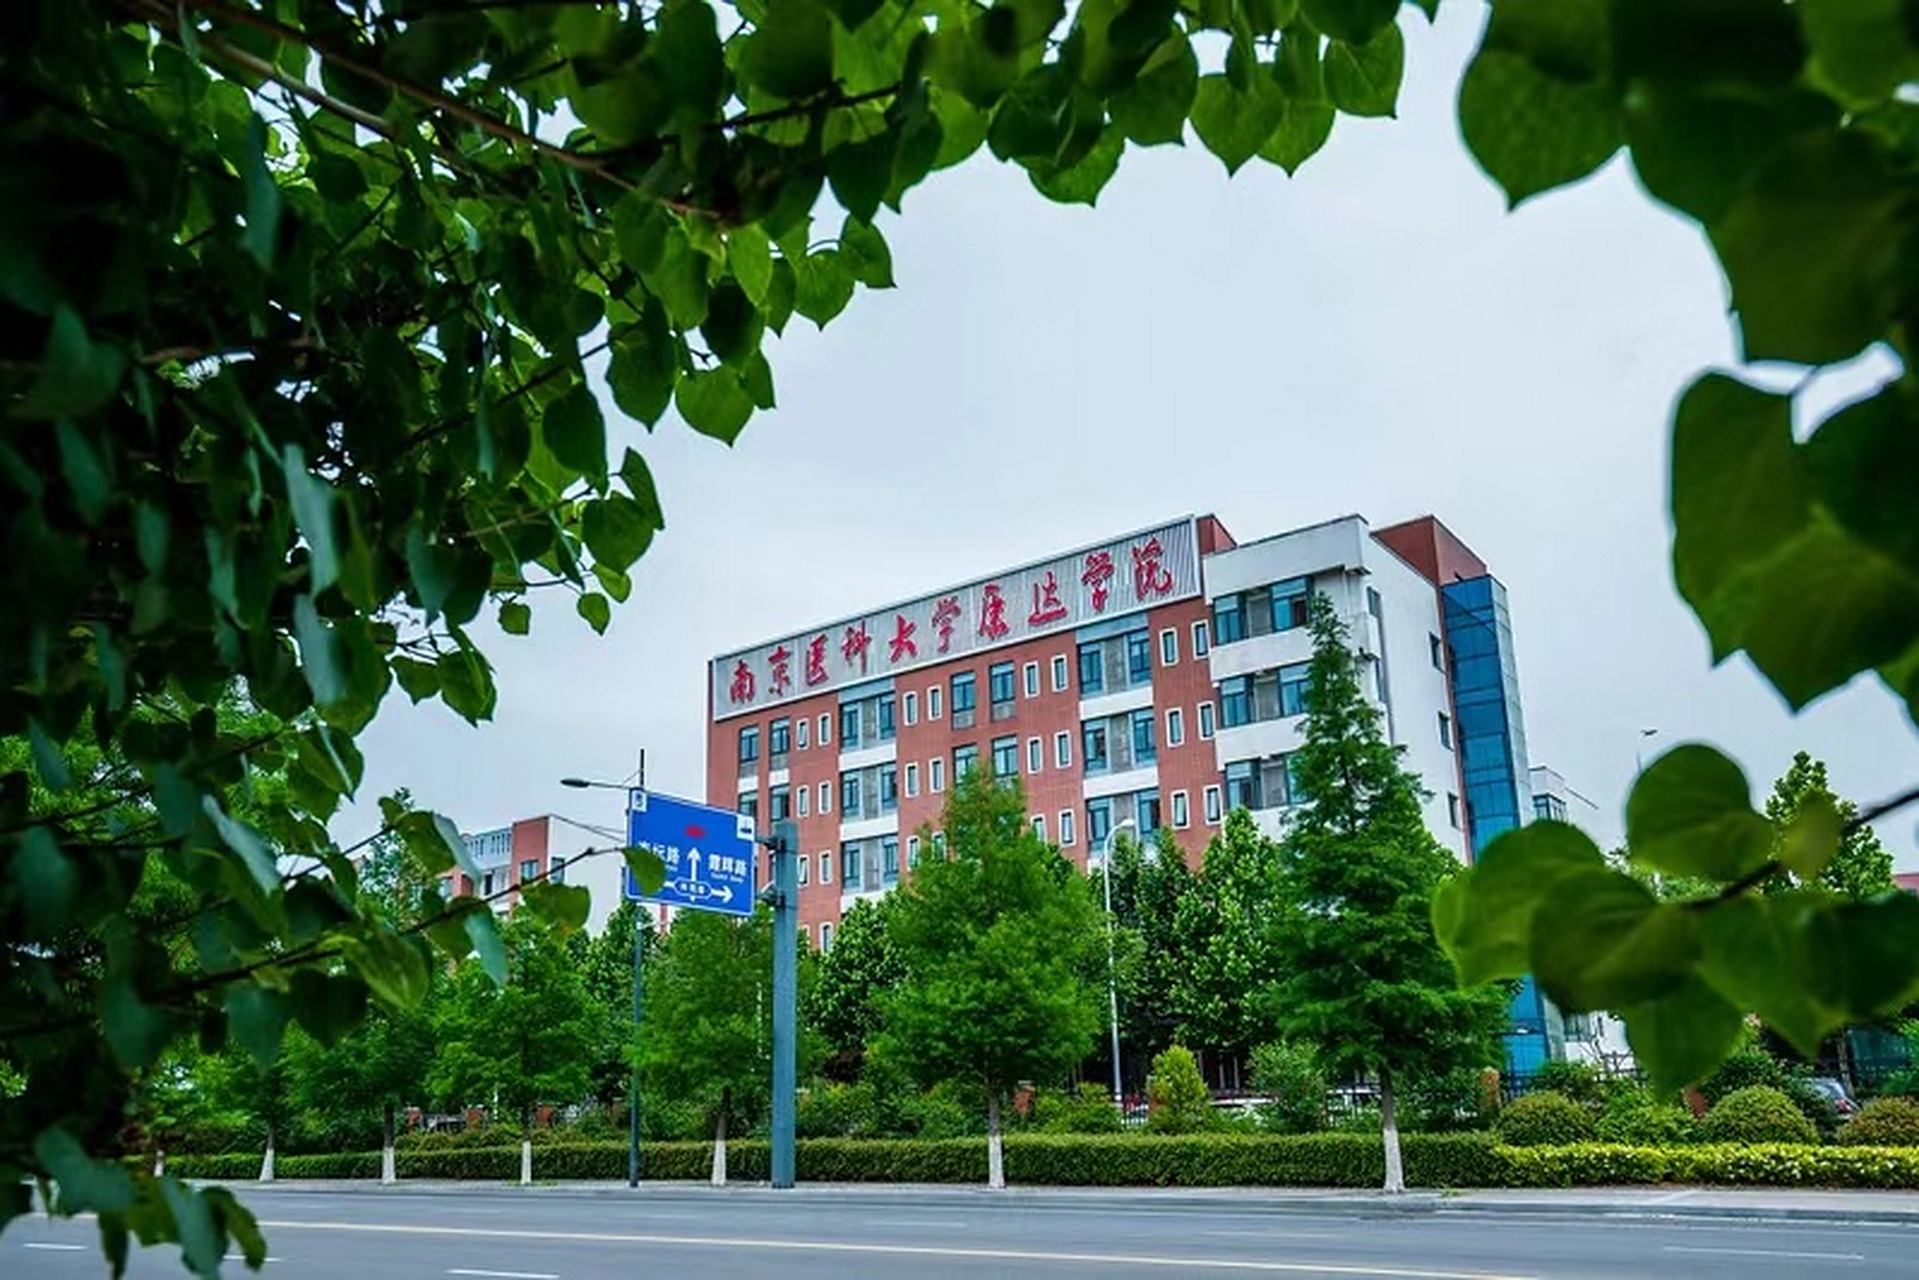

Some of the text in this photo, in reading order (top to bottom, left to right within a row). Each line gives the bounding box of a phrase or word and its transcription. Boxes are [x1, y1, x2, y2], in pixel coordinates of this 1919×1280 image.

[729, 537, 1174, 704] 南京医科大学康达学院
